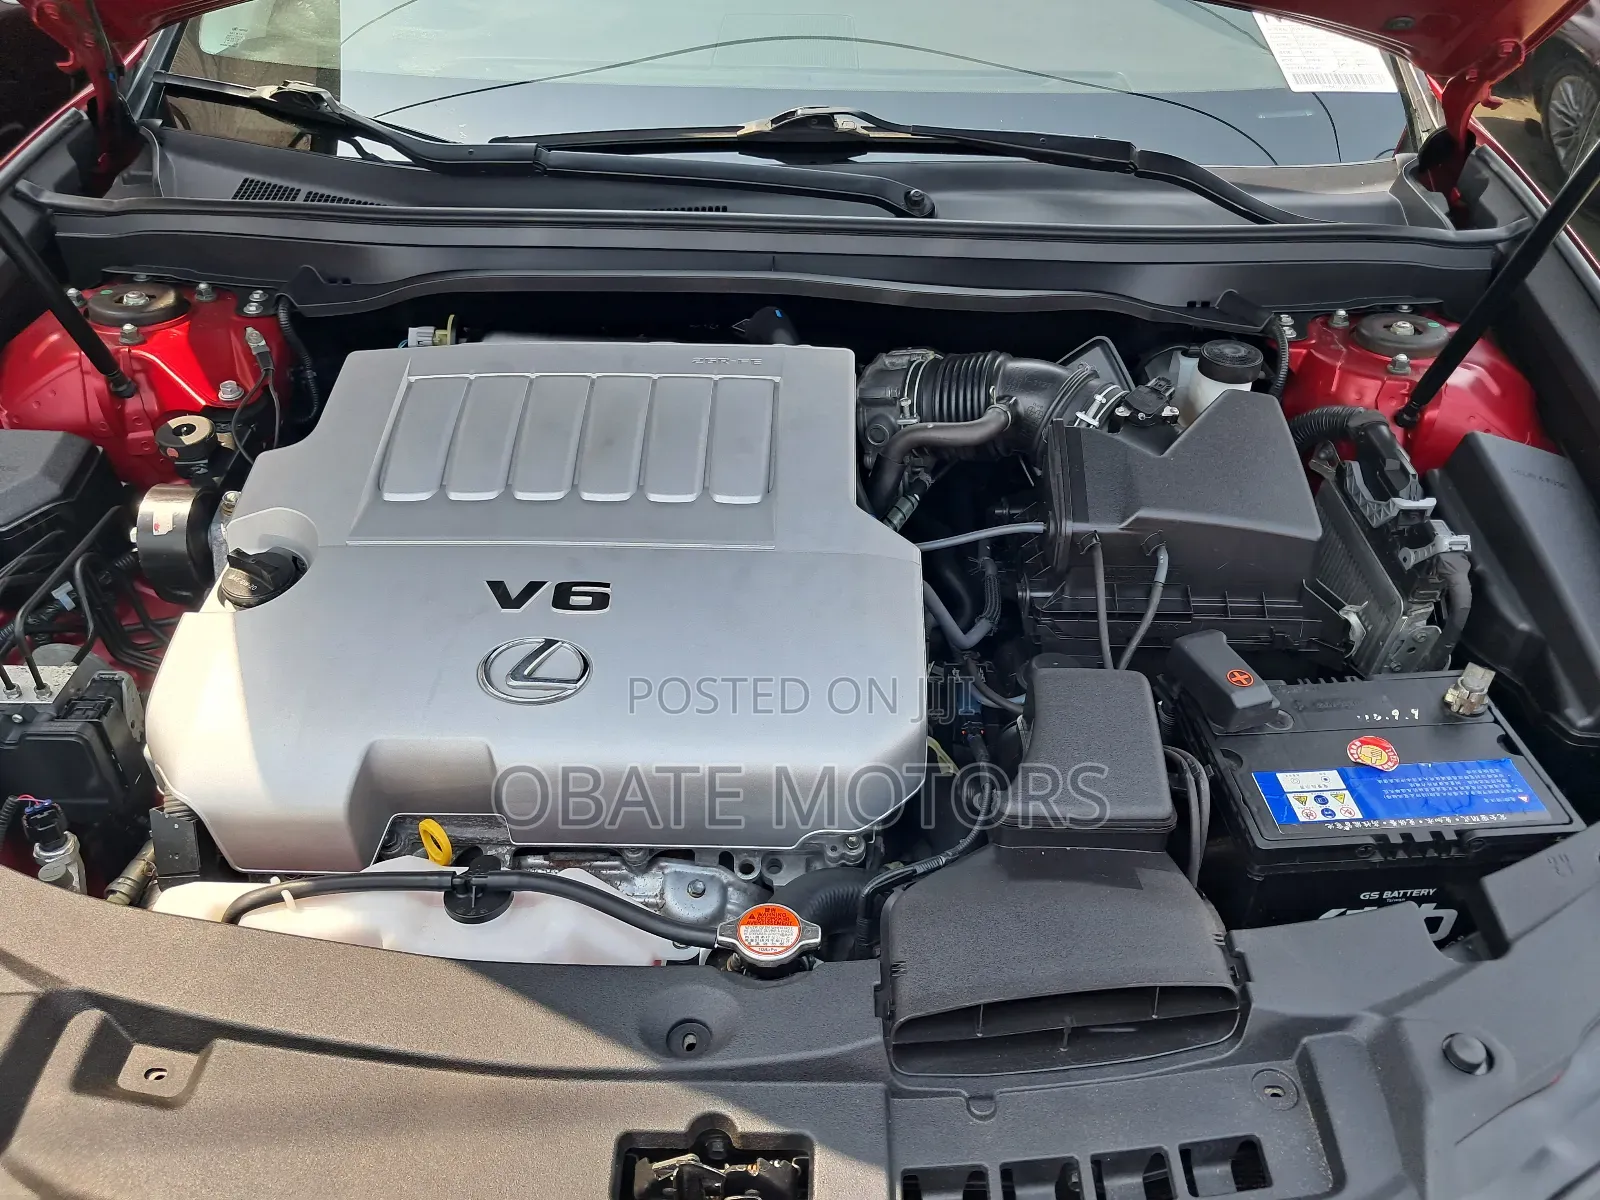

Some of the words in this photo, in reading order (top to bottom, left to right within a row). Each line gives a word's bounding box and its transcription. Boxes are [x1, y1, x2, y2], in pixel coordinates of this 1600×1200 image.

[484, 580, 612, 614] V6
[1360, 892, 1380, 900] GS
[1382, 888, 1438, 898] BATTERY
